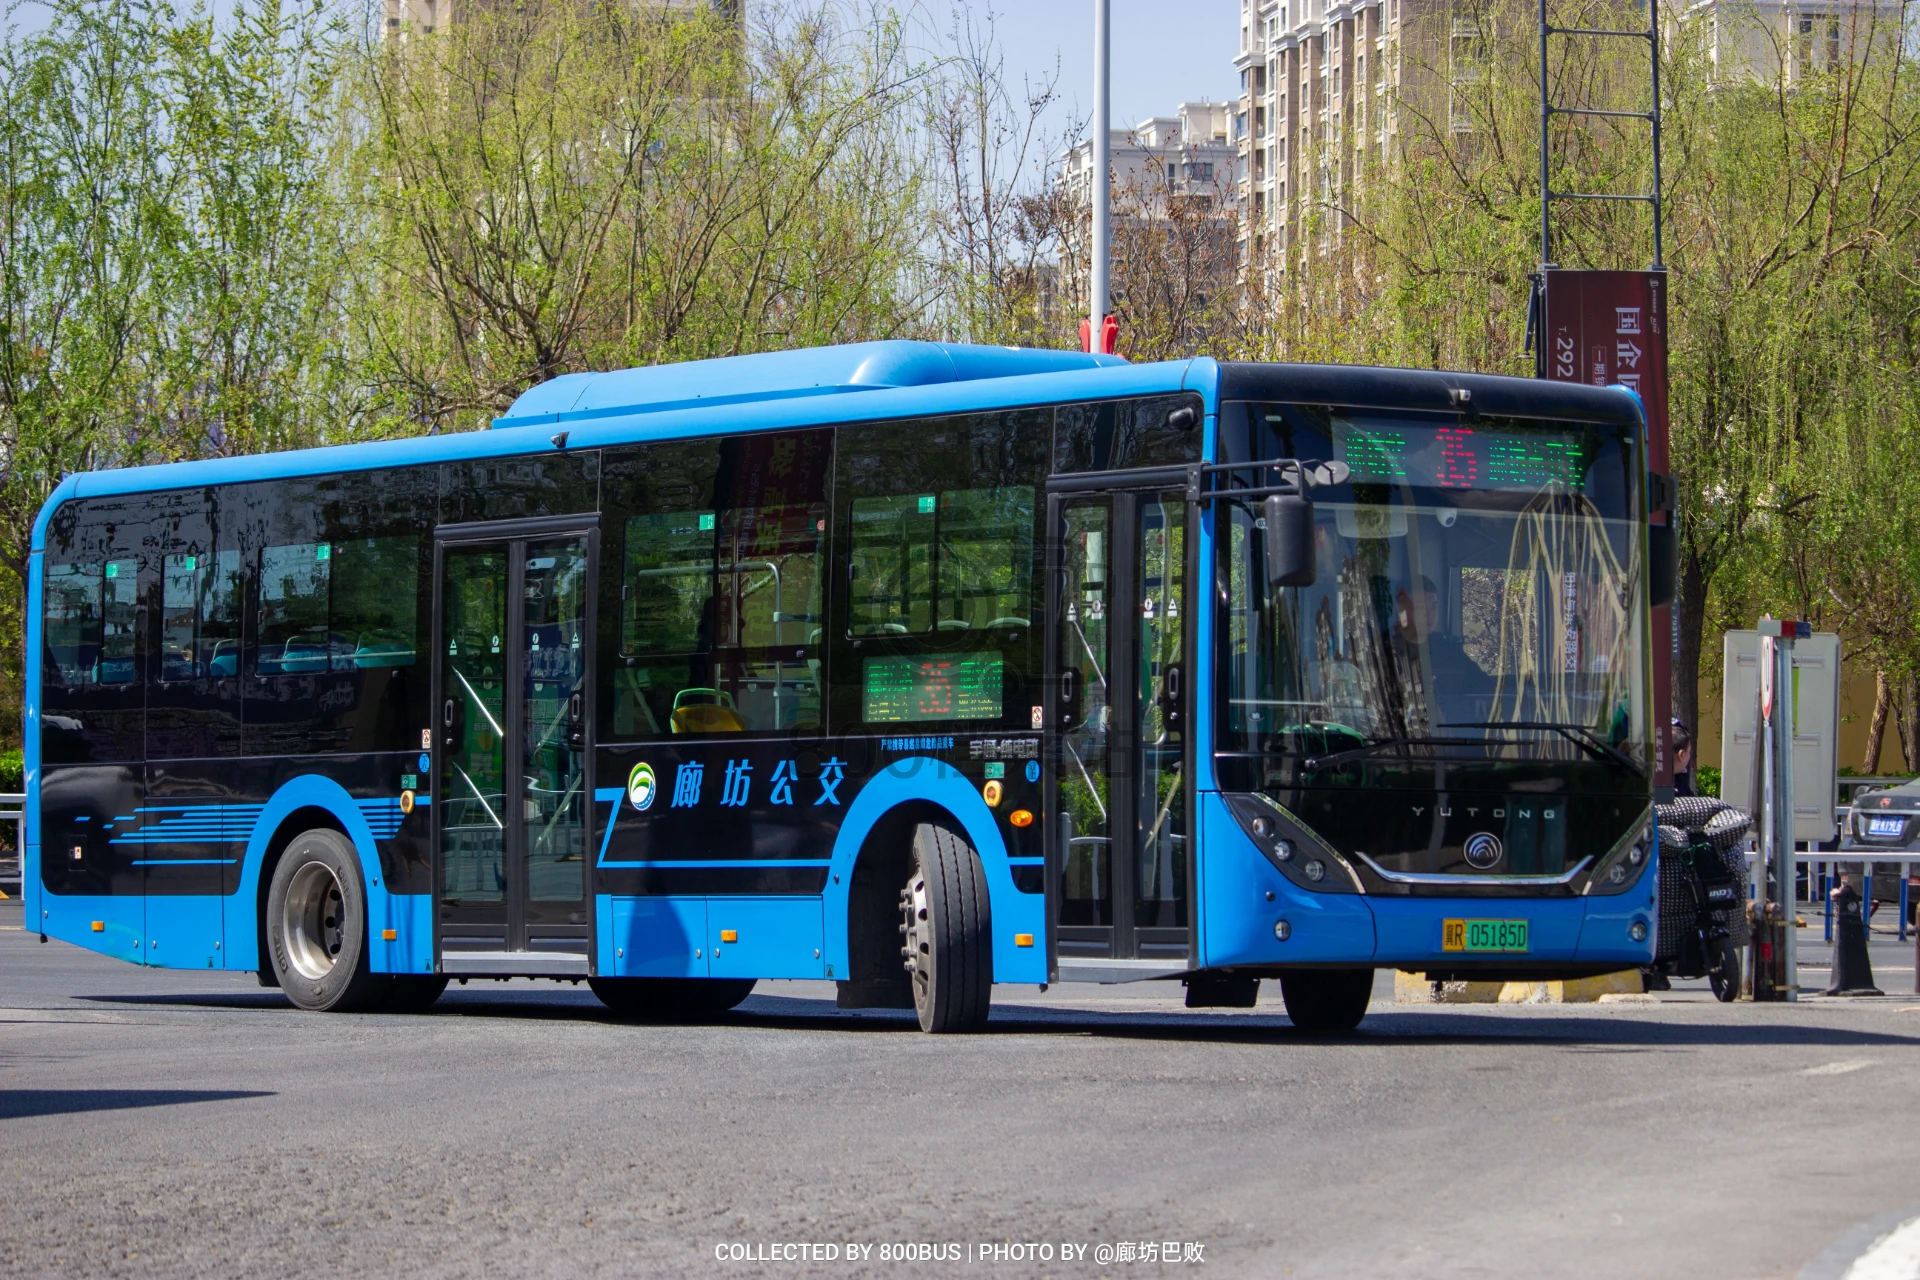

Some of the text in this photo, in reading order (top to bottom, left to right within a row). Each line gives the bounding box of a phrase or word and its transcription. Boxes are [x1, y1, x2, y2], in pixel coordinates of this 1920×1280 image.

[670, 756, 849, 809] 廊坊公交
[1411, 807, 1556, 819] YUTONG
